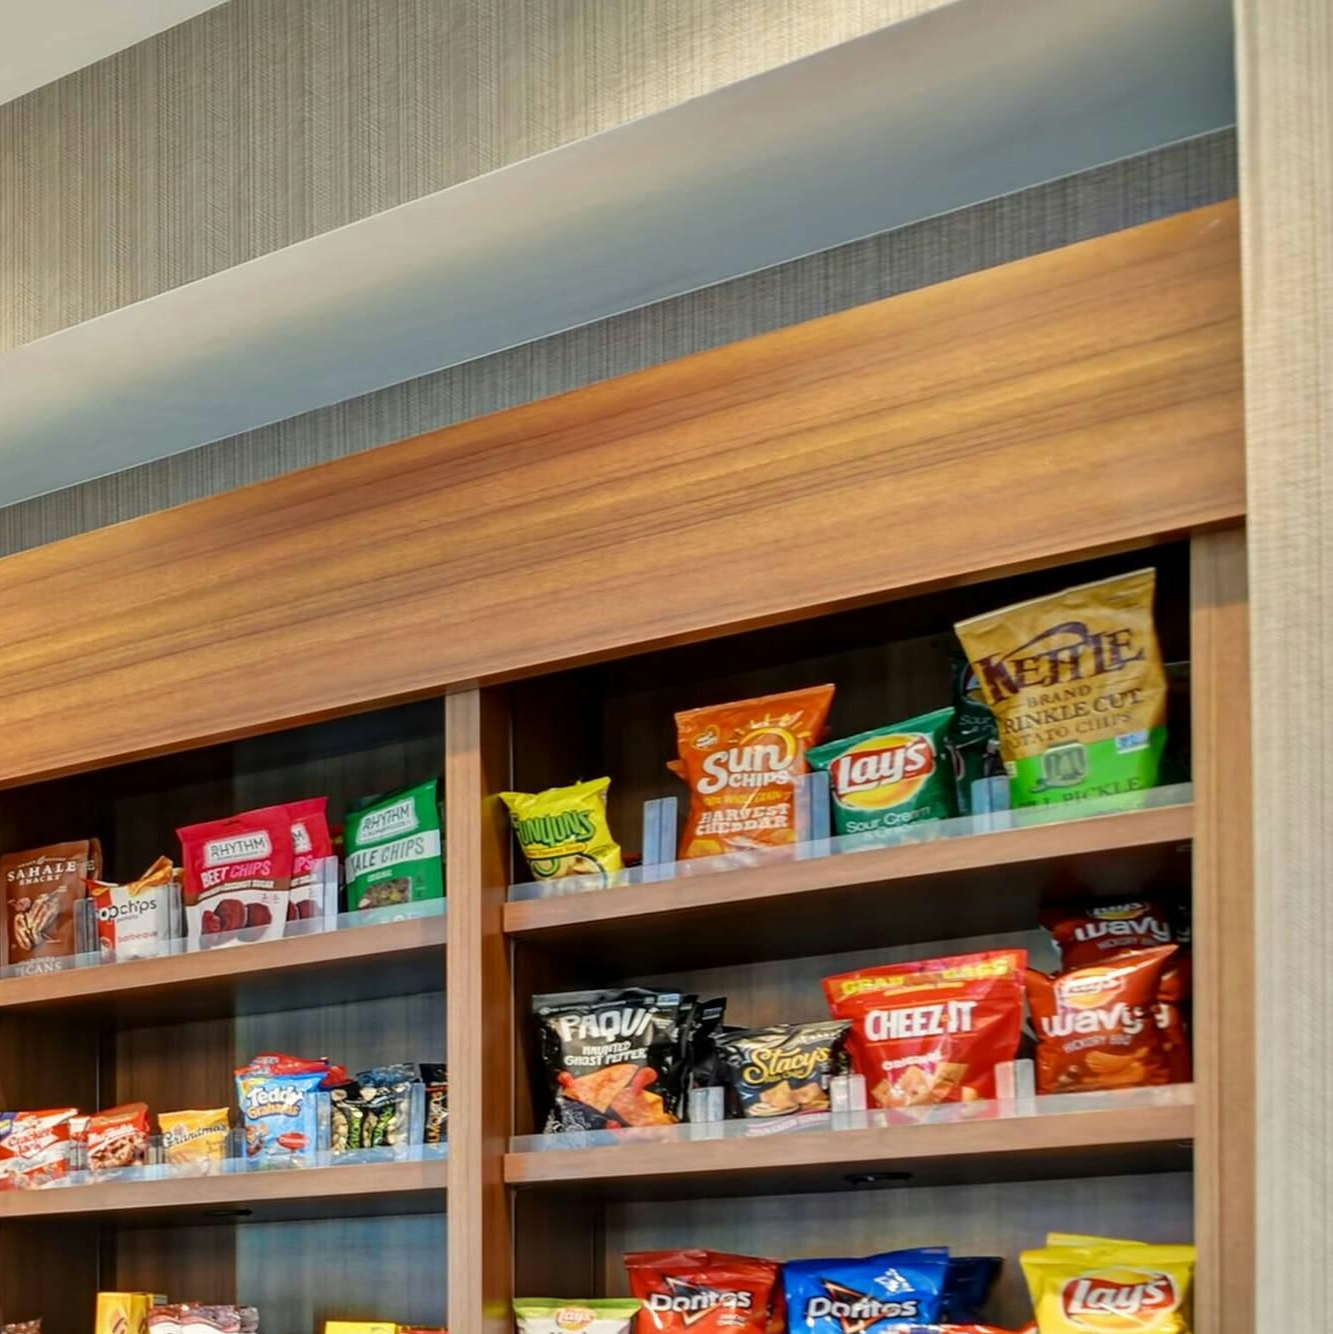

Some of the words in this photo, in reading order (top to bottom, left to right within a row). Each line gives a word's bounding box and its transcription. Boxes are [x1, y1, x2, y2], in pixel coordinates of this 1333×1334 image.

[973, 624, 1146, 705] KETTLE
[1027, 685, 1093, 708] BRAND
[1005, 706, 1090, 735] RINKLE
[1091, 688, 1144, 715] CUT
[1004, 726, 1071, 751] OTATO
[1074, 711, 1133, 735] CHIPS
[697, 742, 792, 794] Sun
[728, 769, 790, 788] CHIPS
[362, 803, 411, 832] RHYTHM
[701, 802, 790, 824] HARVEST
[695, 815, 789, 836] CHEDDAR
[845, 816, 880, 834] Sour
[209, 836, 267, 858] RHYTHM
[379, 836, 426, 863] CHIPS
[6, 860, 78, 882] SAHALE
[201, 866, 228, 886] BEET
[228, 860, 272, 879] CHIPS
[294, 855, 313, 873] IPS
[561, 1007, 658, 1042] PAQUI
[248, 1086, 307, 1106] Teddy
[650, 1290, 752, 1313] Doritos
[806, 1295, 918, 1319] Doritos
